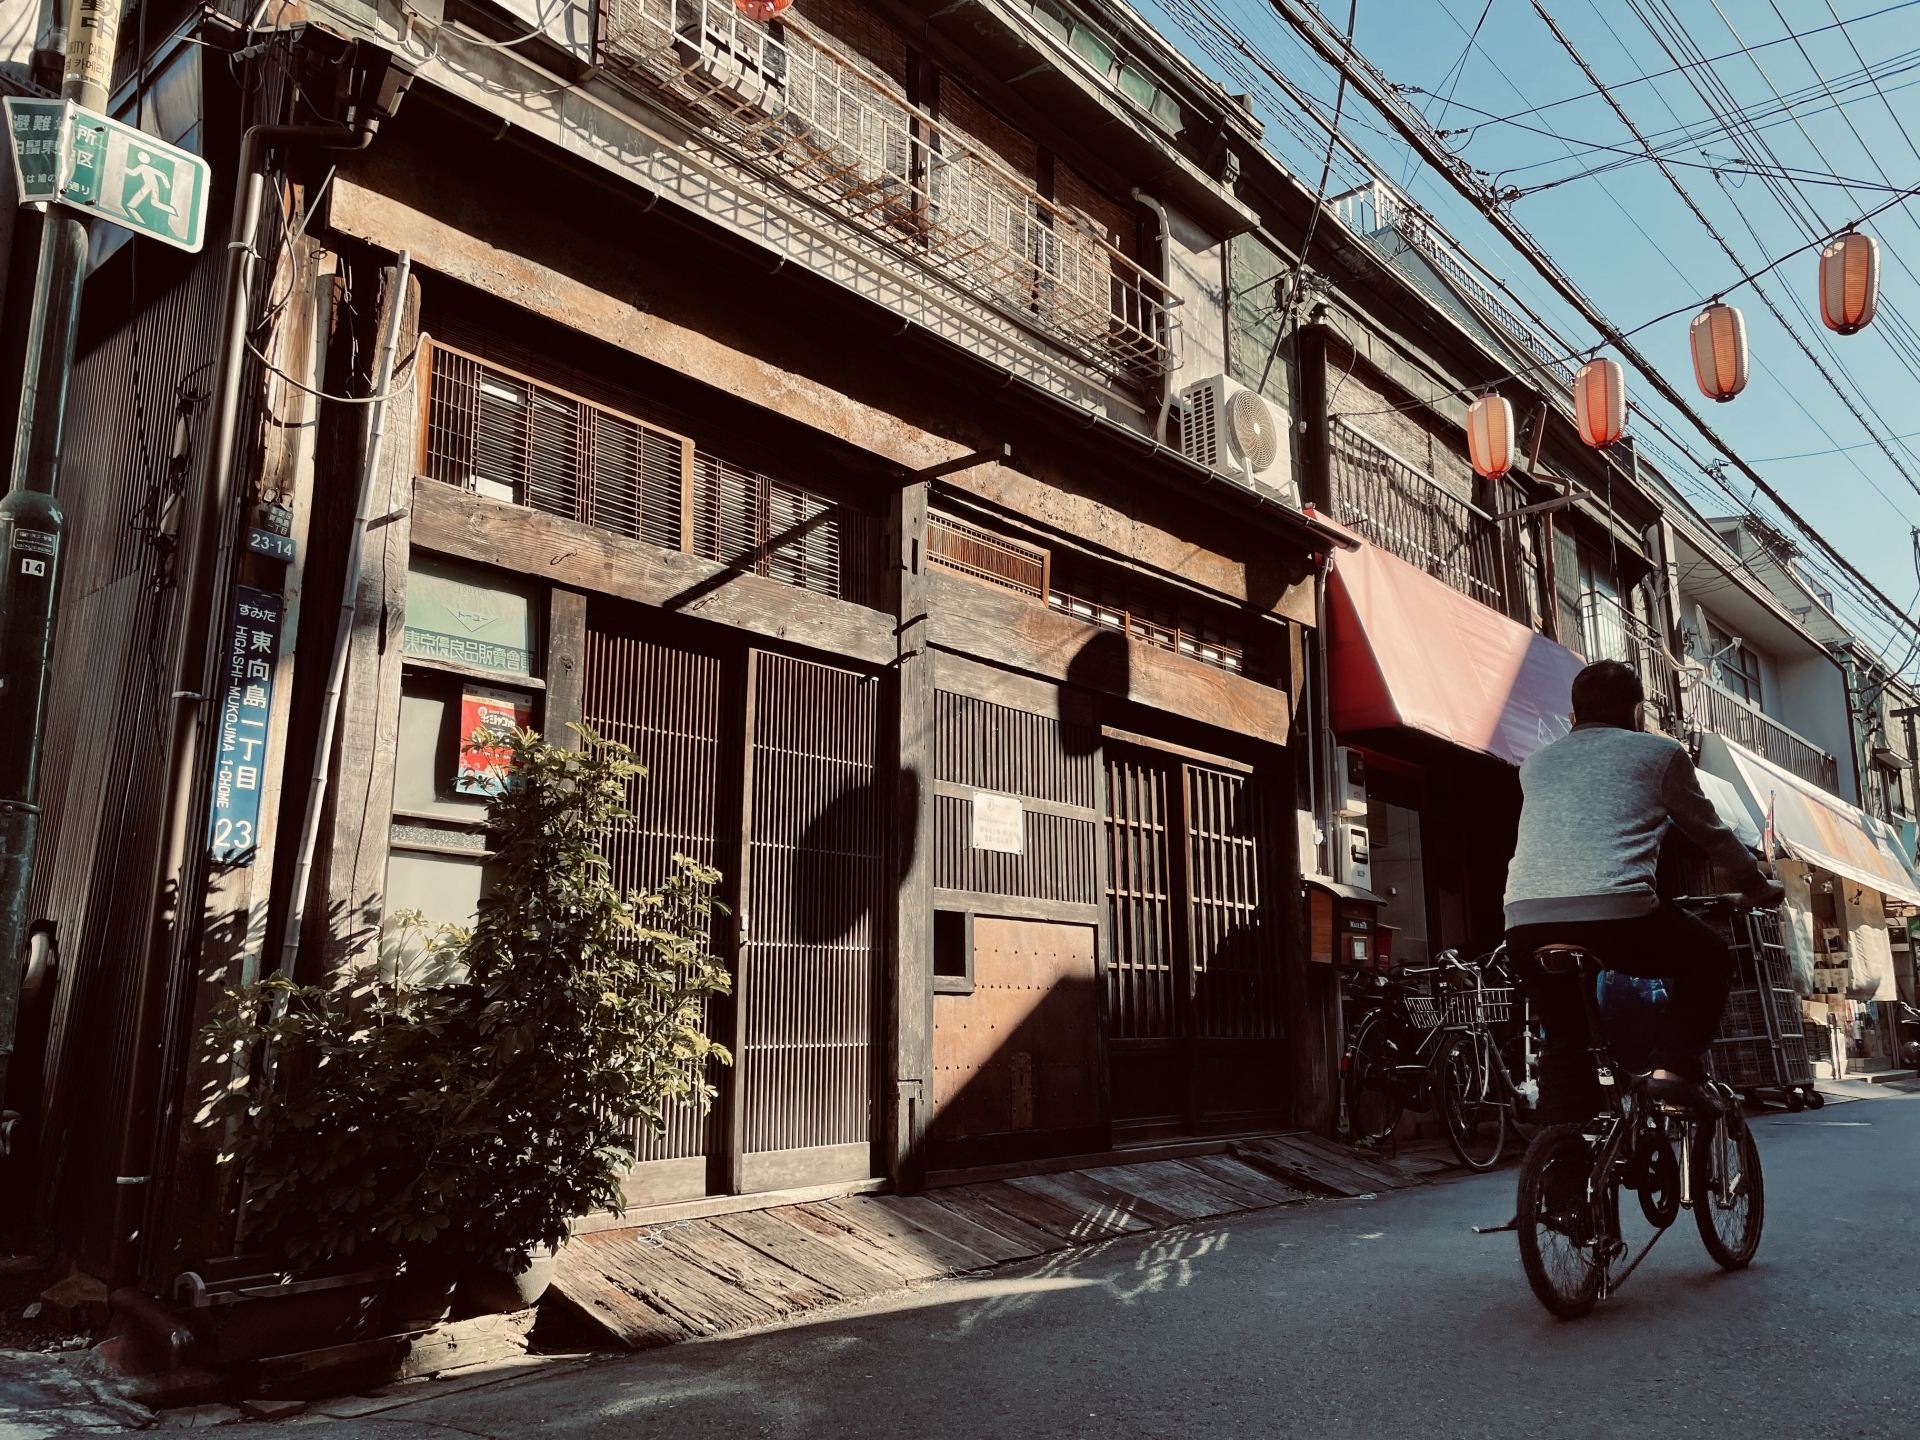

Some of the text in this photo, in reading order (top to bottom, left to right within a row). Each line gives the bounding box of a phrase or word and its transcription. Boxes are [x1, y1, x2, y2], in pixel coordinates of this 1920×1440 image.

[88, 43, 111, 66] CAMERA
[74, 58, 105, 75] 카메라
[250, 533, 293, 556] 23-14
[25, 561, 43, 574] 14
[239, 603, 276, 623] すみだ
[458, 611, 488, 622] トーユー
[216, 625, 248, 809] HIGASHI-MUKOJIMA 1-CHOME
[236, 630, 273, 790] 東向島一丁目
[214, 817, 252, 849] 23
